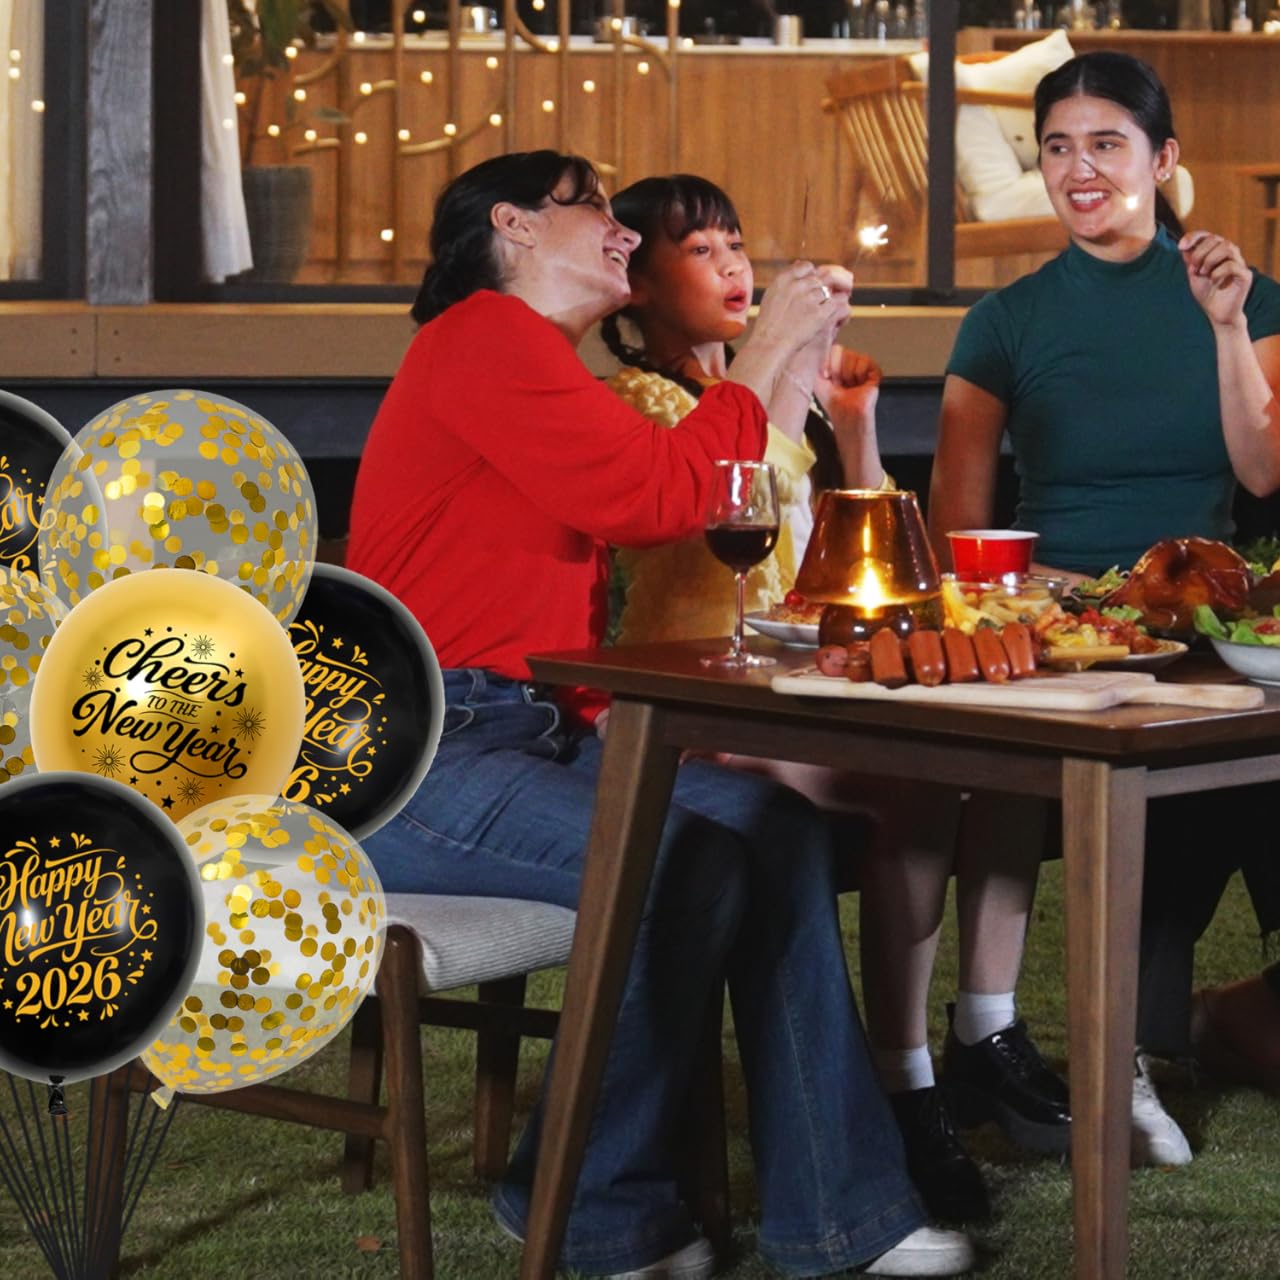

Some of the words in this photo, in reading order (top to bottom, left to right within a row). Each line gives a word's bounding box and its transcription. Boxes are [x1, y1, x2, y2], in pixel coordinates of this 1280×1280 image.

[103, 636, 248, 707] Cheers
[147, 693, 168, 711] TO
[170, 698, 203, 719] THE
[290, 632, 383, 724] appy
[71, 689, 164, 737] New
[129, 721, 248, 780] Year
[0, 848, 125, 911] Happy
[55, 889, 158, 963] Year
[15, 956, 122, 1017] 2026
